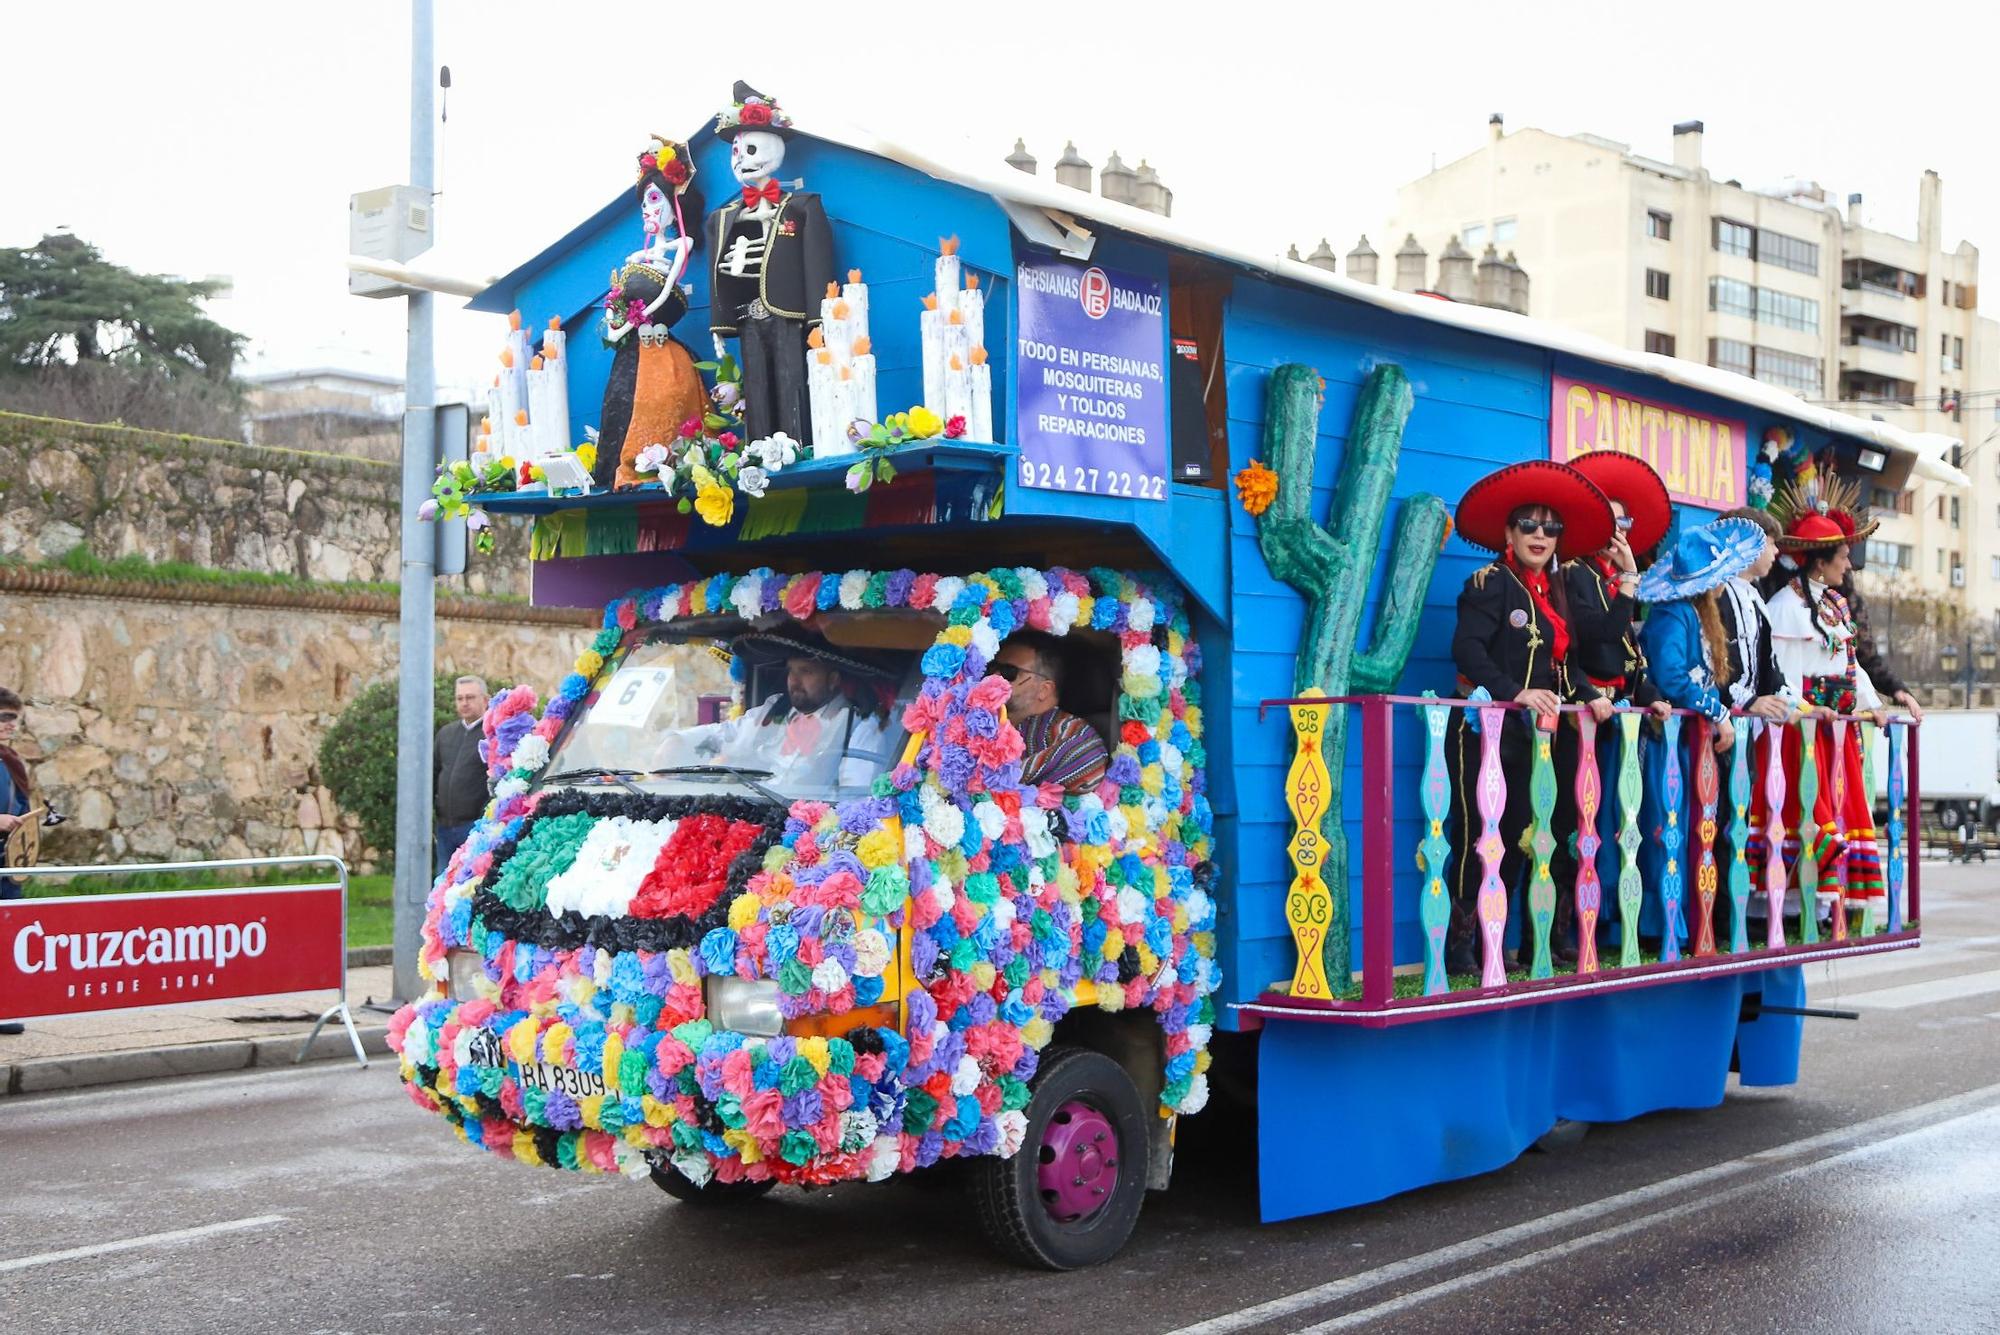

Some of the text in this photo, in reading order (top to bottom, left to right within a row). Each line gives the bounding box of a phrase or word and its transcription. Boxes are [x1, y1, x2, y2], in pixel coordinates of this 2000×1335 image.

[1018, 264, 1162, 317] PERSIANAS BADAJOZ
[1019, 339, 1163, 383] TODO EN PERSIANAS,
[1043, 368, 1143, 399] MOSQUITERAS
[1057, 393, 1126, 420] Y TOLDOS
[1038, 415, 1146, 444] REPARACIONES
[1568, 385, 1736, 503] CANTINA
[1074, 467, 1098, 492] 27
[1107, 471, 1132, 496] 22
[1139, 475, 1163, 498] 22
[618, 680, 643, 705] 6
[14, 918, 267, 974] Cruzcampo
[68, 973, 215, 998] DESDE 1904
[522, 1063, 549, 1092] BA
[553, 1065, 606, 1098] 8309
